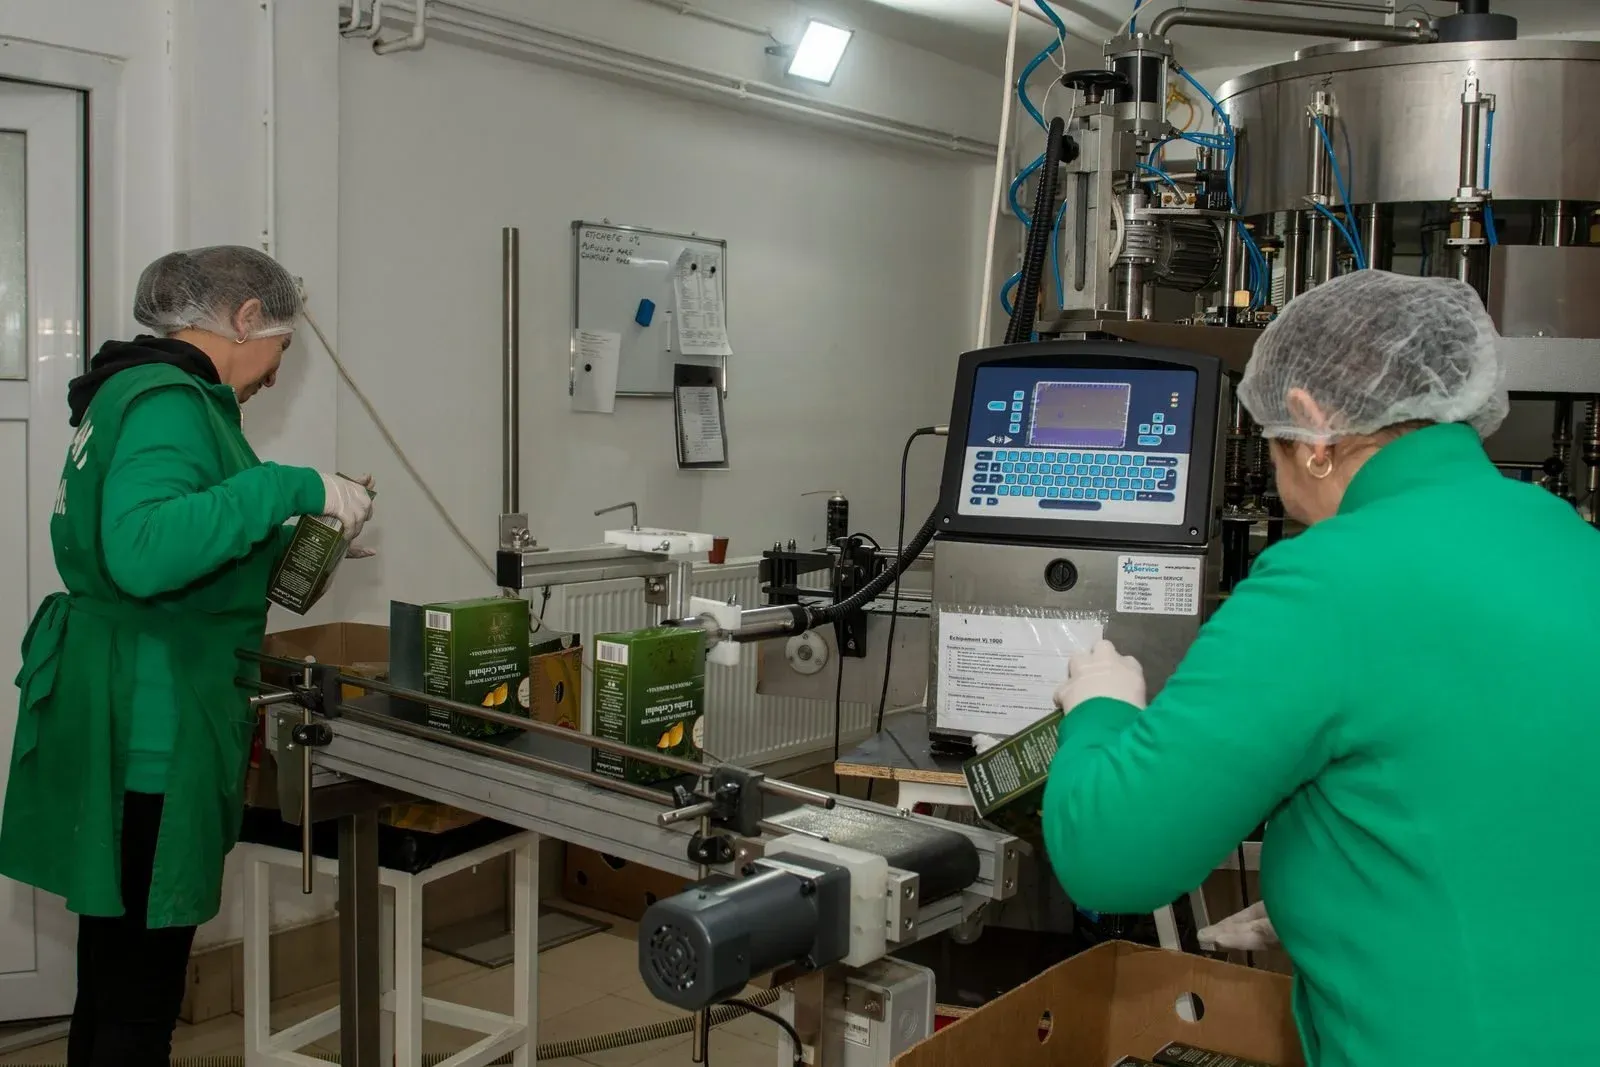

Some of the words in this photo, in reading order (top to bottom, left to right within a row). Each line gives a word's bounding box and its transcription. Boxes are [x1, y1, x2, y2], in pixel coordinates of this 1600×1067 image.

[585, 230, 623, 242] ETICHETE
[1133, 565, 1159, 573] Service
[949, 634, 981, 643] Echipament
[468, 666, 497, 677] Cerbului
[498, 663, 517, 672] Limba
[645, 703, 674, 716] Cerbului
[674, 700, 693, 711] Limba
